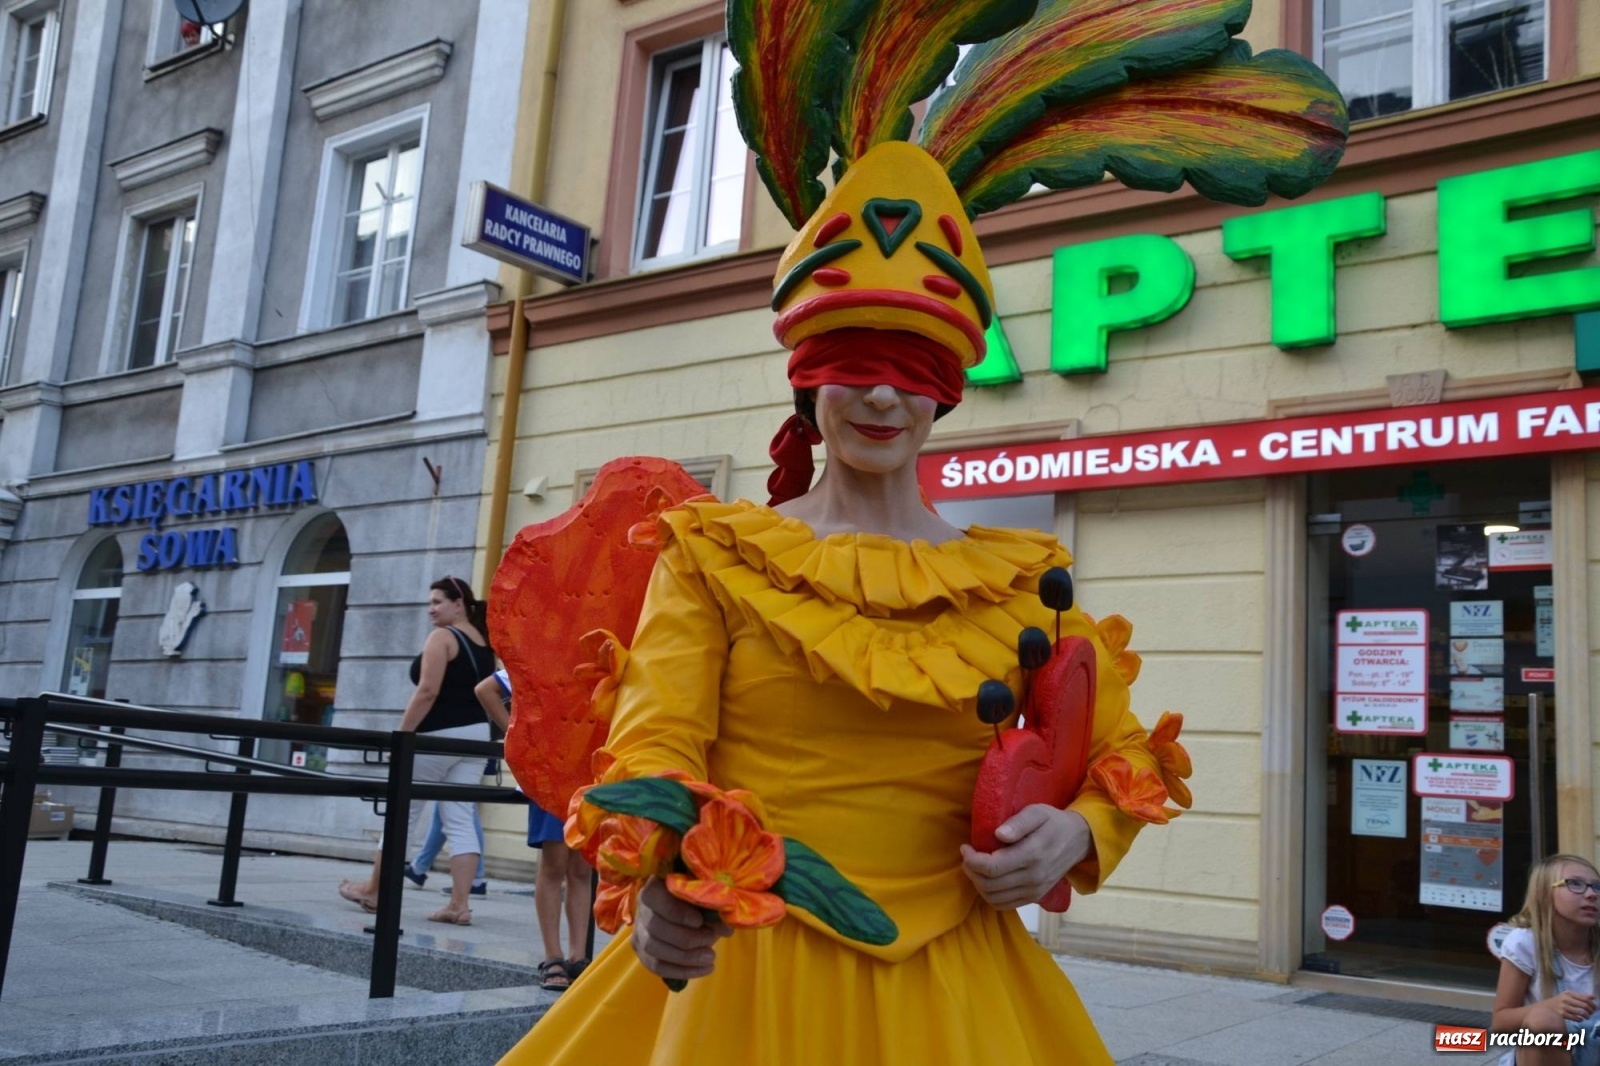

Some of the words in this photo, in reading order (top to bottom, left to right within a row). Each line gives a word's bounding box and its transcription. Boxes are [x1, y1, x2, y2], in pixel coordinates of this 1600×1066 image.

[505, 204, 567, 243] KANCELARIA
[484, 218, 522, 246] RADCY
[522, 234, 581, 270] PRAWNEGO
[965, 150, 1600, 386] PTE
[941, 438, 1221, 488] ŚRÓDMIEJSKA
[1232, 449, 1247, 457] -
[1259, 412, 1499, 460] CENTRUM
[88, 460, 317, 530] KSIĘGARNIA
[136, 527, 238, 571] SOWA
[1364, 620, 1418, 628] APTEKA
[1462, 605, 1492, 617] NFZ
[1353, 658, 1409, 666] OTWARCIA:
[1364, 715, 1414, 723] APTEKA
[1360, 765, 1402, 784] NFZ
[1445, 762, 1497, 771] APTEKA
